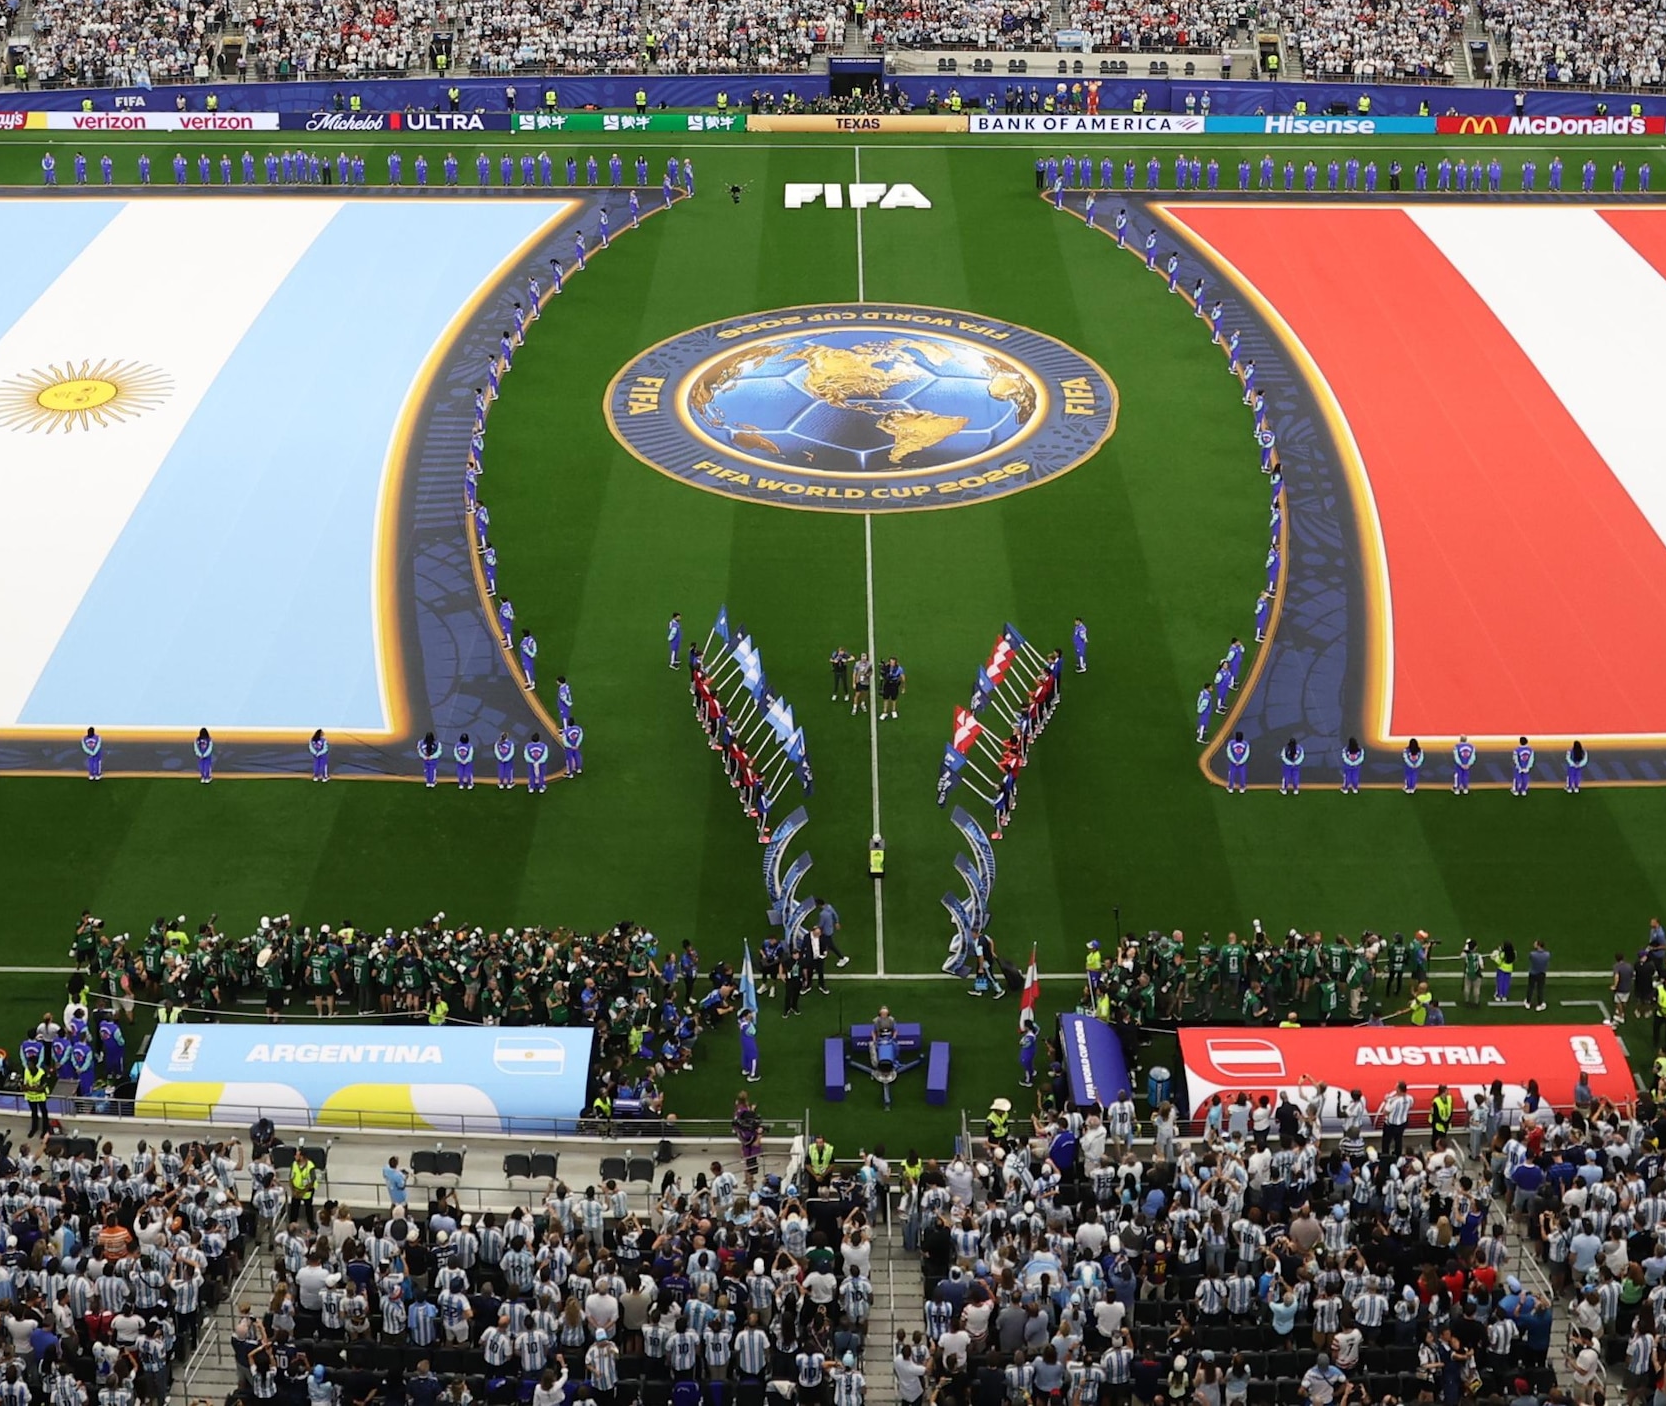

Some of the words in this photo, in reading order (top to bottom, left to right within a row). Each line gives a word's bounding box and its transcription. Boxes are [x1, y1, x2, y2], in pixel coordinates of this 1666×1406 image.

[114, 96, 146, 107] FIFA
[72, 113, 146, 130] verizon
[179, 113, 253, 130] verizon
[305, 113, 384, 131] Michelob
[407, 115, 485, 130] ULTRA
[835, 118, 880, 129] TEXAS
[978, 116, 1037, 131] BANK
[1044, 116, 1072, 131] OF
[1075, 116, 1172, 131] AMERICA
[1264, 116, 1376, 134] Hisense
[1507, 117, 1646, 135] McDonald's
[784, 183, 932, 209] FIFA
[807, 312, 859, 323] CUP
[862, 312, 952, 327] WORLD
[716, 316, 804, 340] 2026
[958, 321, 1011, 342] FIFA
[628, 376, 666, 416] FIFA
[1060, 376, 1096, 415] FIFA
[692, 460, 752, 486] FIFA
[755, 477, 867, 499] WORLD
[871, 484, 931, 499] CUP
[934, 460, 1032, 494] 2026
[244, 1044, 443, 1064] ARGENTINA
[1355, 1046, 1507, 1065] AUSTRIA
[720, 1184, 731, 1196] 10
[263, 1200, 274, 1211] 10
[324, 1302, 337, 1315] 10
[527, 1341, 538, 1355] 10
[679, 1343, 689, 1355] 10
[1346, 1343, 1355, 1357] 7
